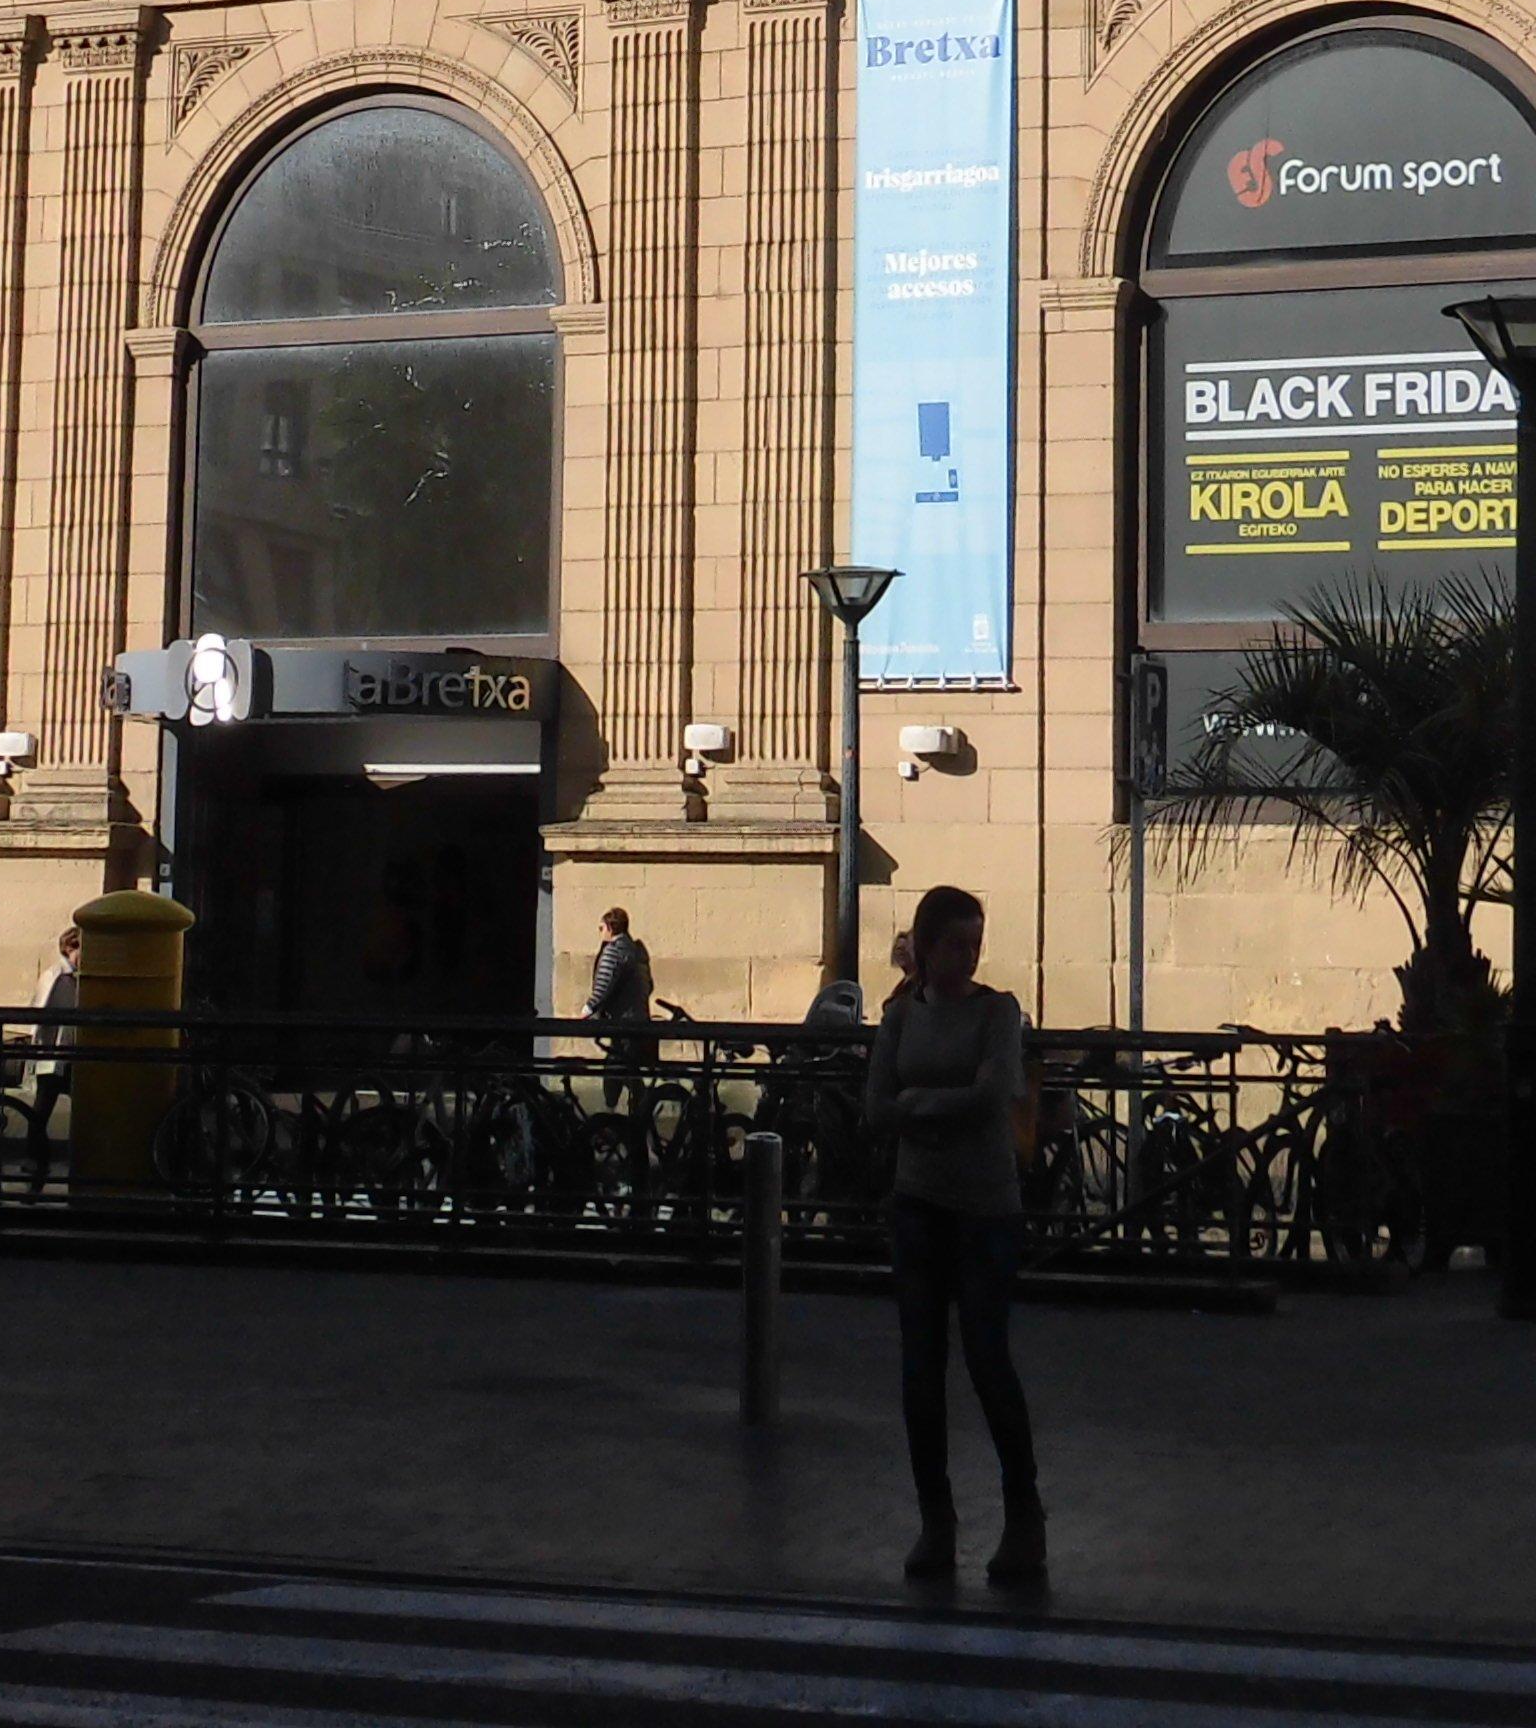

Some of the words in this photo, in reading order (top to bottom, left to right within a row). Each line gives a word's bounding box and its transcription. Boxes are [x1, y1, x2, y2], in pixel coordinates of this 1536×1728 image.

[866, 31, 1001, 67] Bretxa
[865, 162, 1000, 192] Irisgarriagoa
[1279, 158, 1392, 195] forum
[1402, 153, 1502, 195] sport
[884, 249, 978, 278] Mejores
[888, 279, 975, 300] accesos
[1185, 374, 1354, 424] BLACK
[1364, 369, 1518, 417] FRIDA
[1318, 466, 1346, 477] ARTE
[1378, 466, 1401, 480] NO
[1403, 464, 1469, 479] ESPERES
[1472, 462, 1483, 476] A
[1189, 480, 1350, 521] KIROLA
[1415, 480, 1455, 496] PARA
[1459, 479, 1512, 494] HACER
[1239, 522, 1298, 537] EGITEKO
